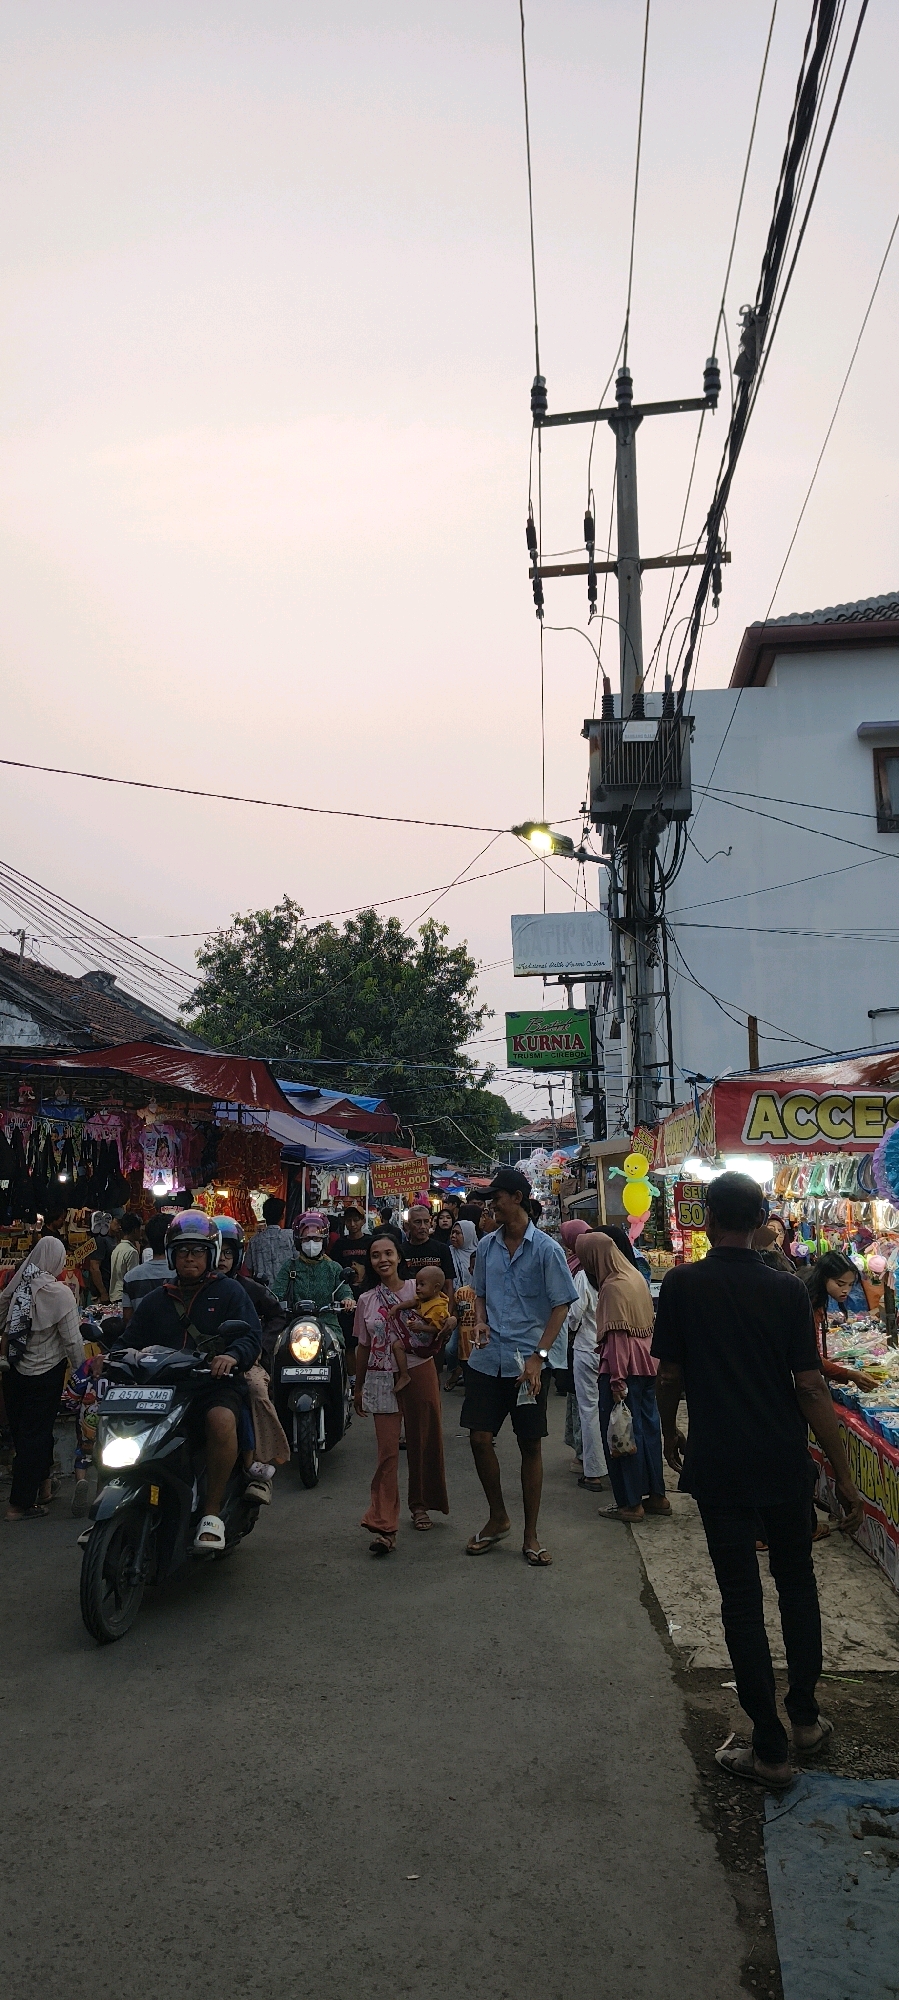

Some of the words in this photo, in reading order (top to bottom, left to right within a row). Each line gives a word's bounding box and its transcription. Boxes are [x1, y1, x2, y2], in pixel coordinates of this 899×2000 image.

[525, 1017, 572, 1032] Batik
[512, 1033, 586, 1052] KURNIA
[375, 1164, 397, 1172] Harga
[399, 1160, 424, 1168] Spesial
[375, 1181, 391, 1190] Rp.
[394, 1175, 428, 1187] 35.000
[108, 1391, 116, 1400] B
[119, 1390, 144, 1400] 4570
[148, 1391, 169, 1400] SMB
